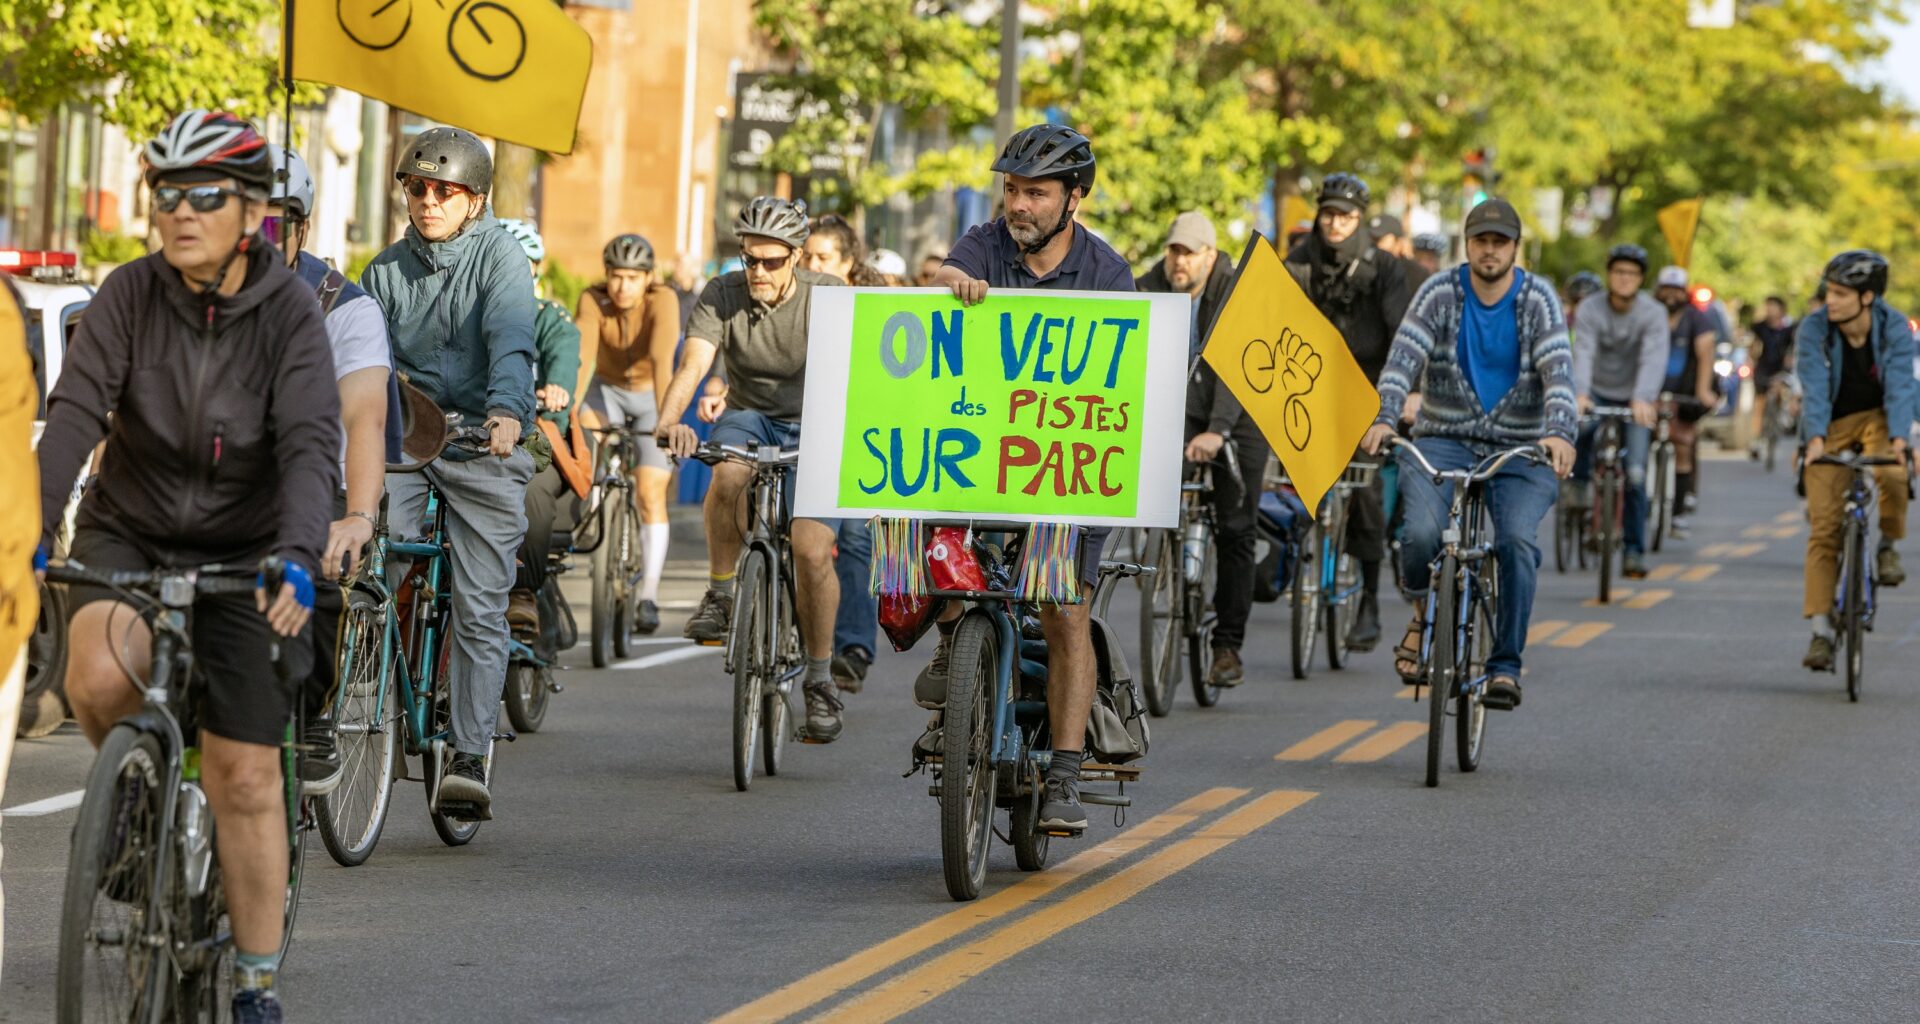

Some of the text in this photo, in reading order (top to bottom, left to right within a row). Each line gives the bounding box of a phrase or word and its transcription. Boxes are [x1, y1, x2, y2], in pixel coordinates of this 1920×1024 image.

[880, 309, 1140, 389] ON VEUT
[950, 385, 988, 417] des
[858, 427, 1125, 498] SUR PARC
